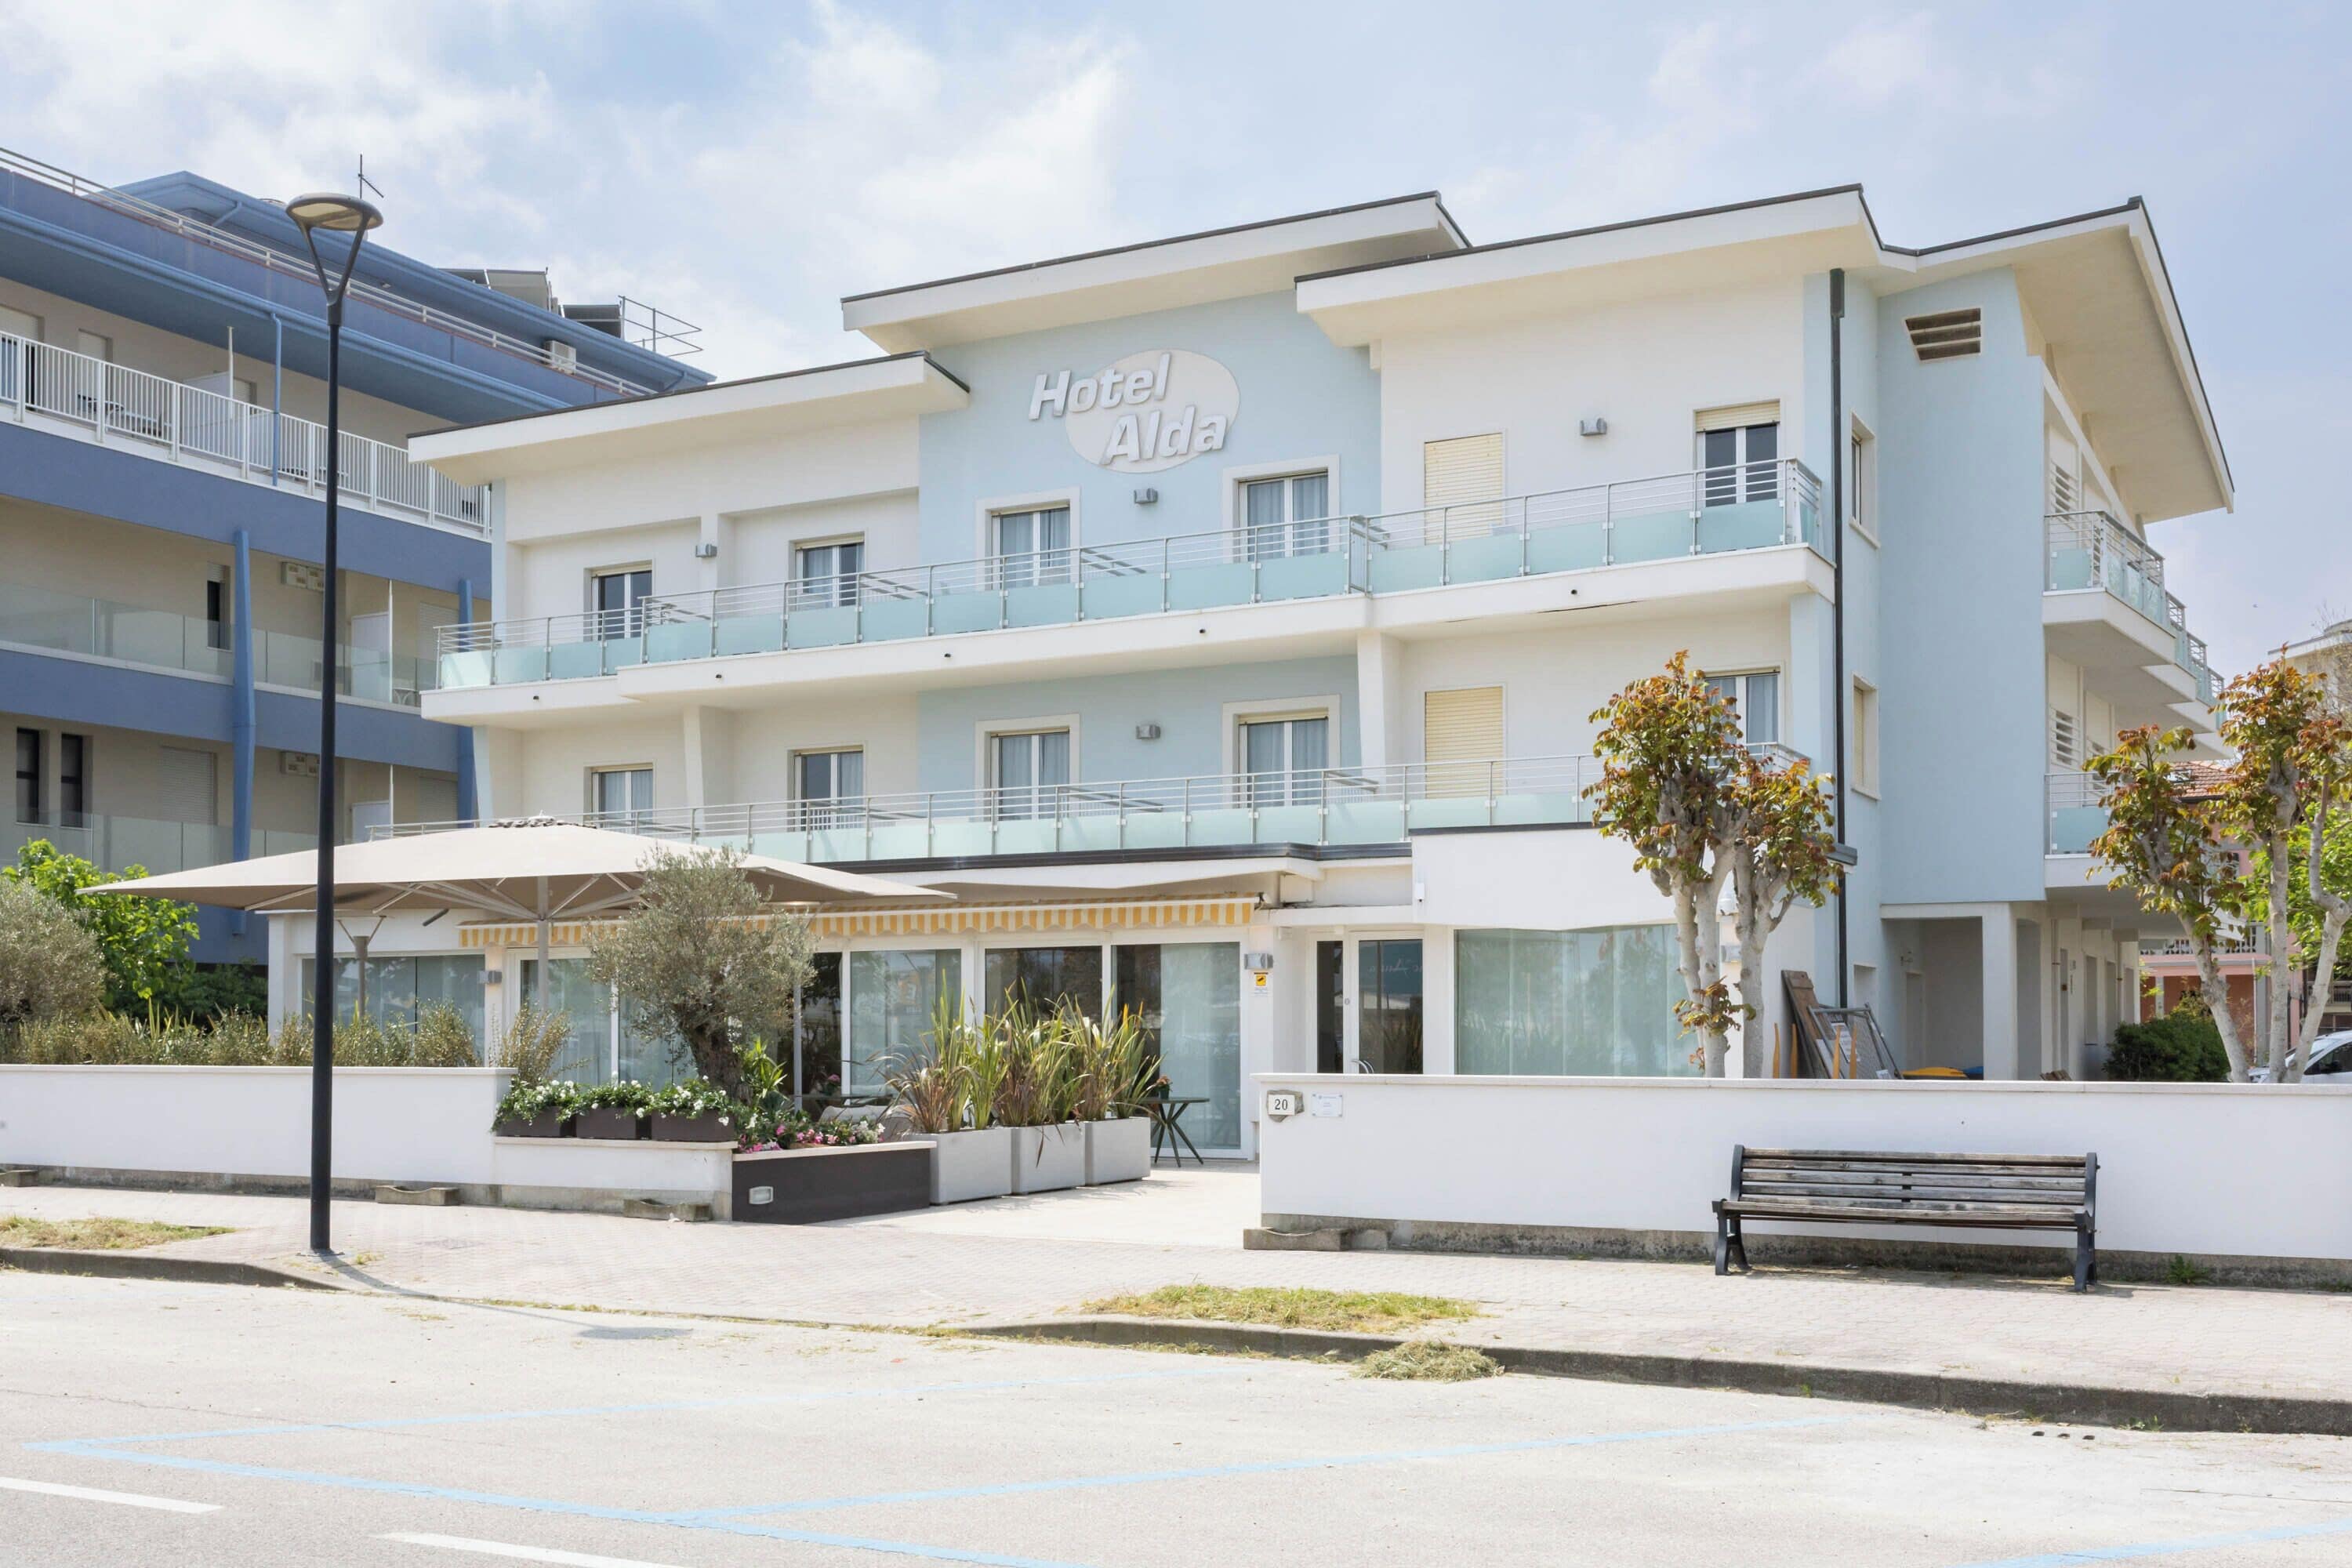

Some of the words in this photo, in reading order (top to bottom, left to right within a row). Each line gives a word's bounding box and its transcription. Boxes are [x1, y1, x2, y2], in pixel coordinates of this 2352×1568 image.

[1029, 353, 1171, 420] Hotel
[1099, 405, 1227, 465] Alda
[1274, 1098, 1288, 1110] 20
